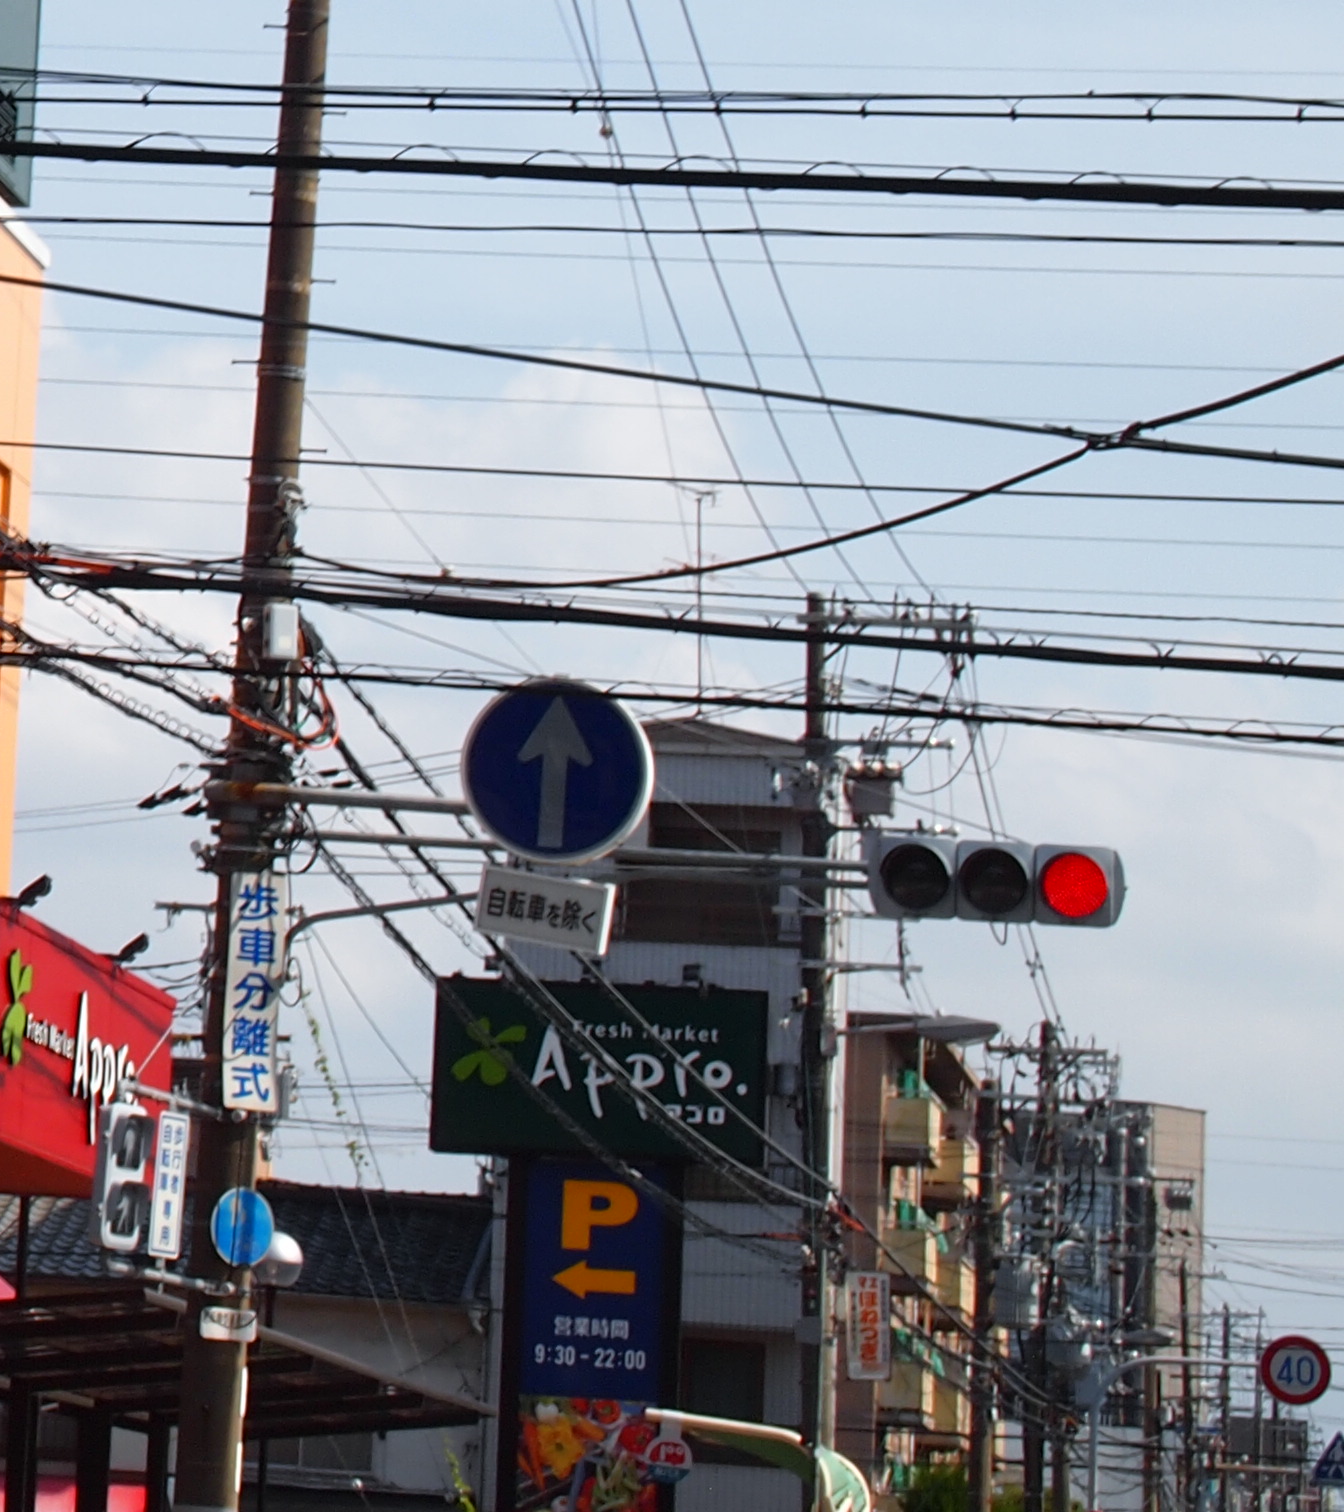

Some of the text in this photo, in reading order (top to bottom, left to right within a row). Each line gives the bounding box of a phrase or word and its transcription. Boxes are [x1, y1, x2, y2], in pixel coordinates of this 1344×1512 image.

[486, 887, 597, 934] 自転車を除く
[232, 883, 278, 1102] 歩車分離式
[26, 1012, 75, 1061] Fresh Market
[573, 1020, 633, 1038] Fresh
[531, 1023, 749, 1121] Appro.
[561, 1179, 639, 1250] P
[553, 1315, 630, 1340] 営業時間
[1276, 1355, 1315, 1387] 40
